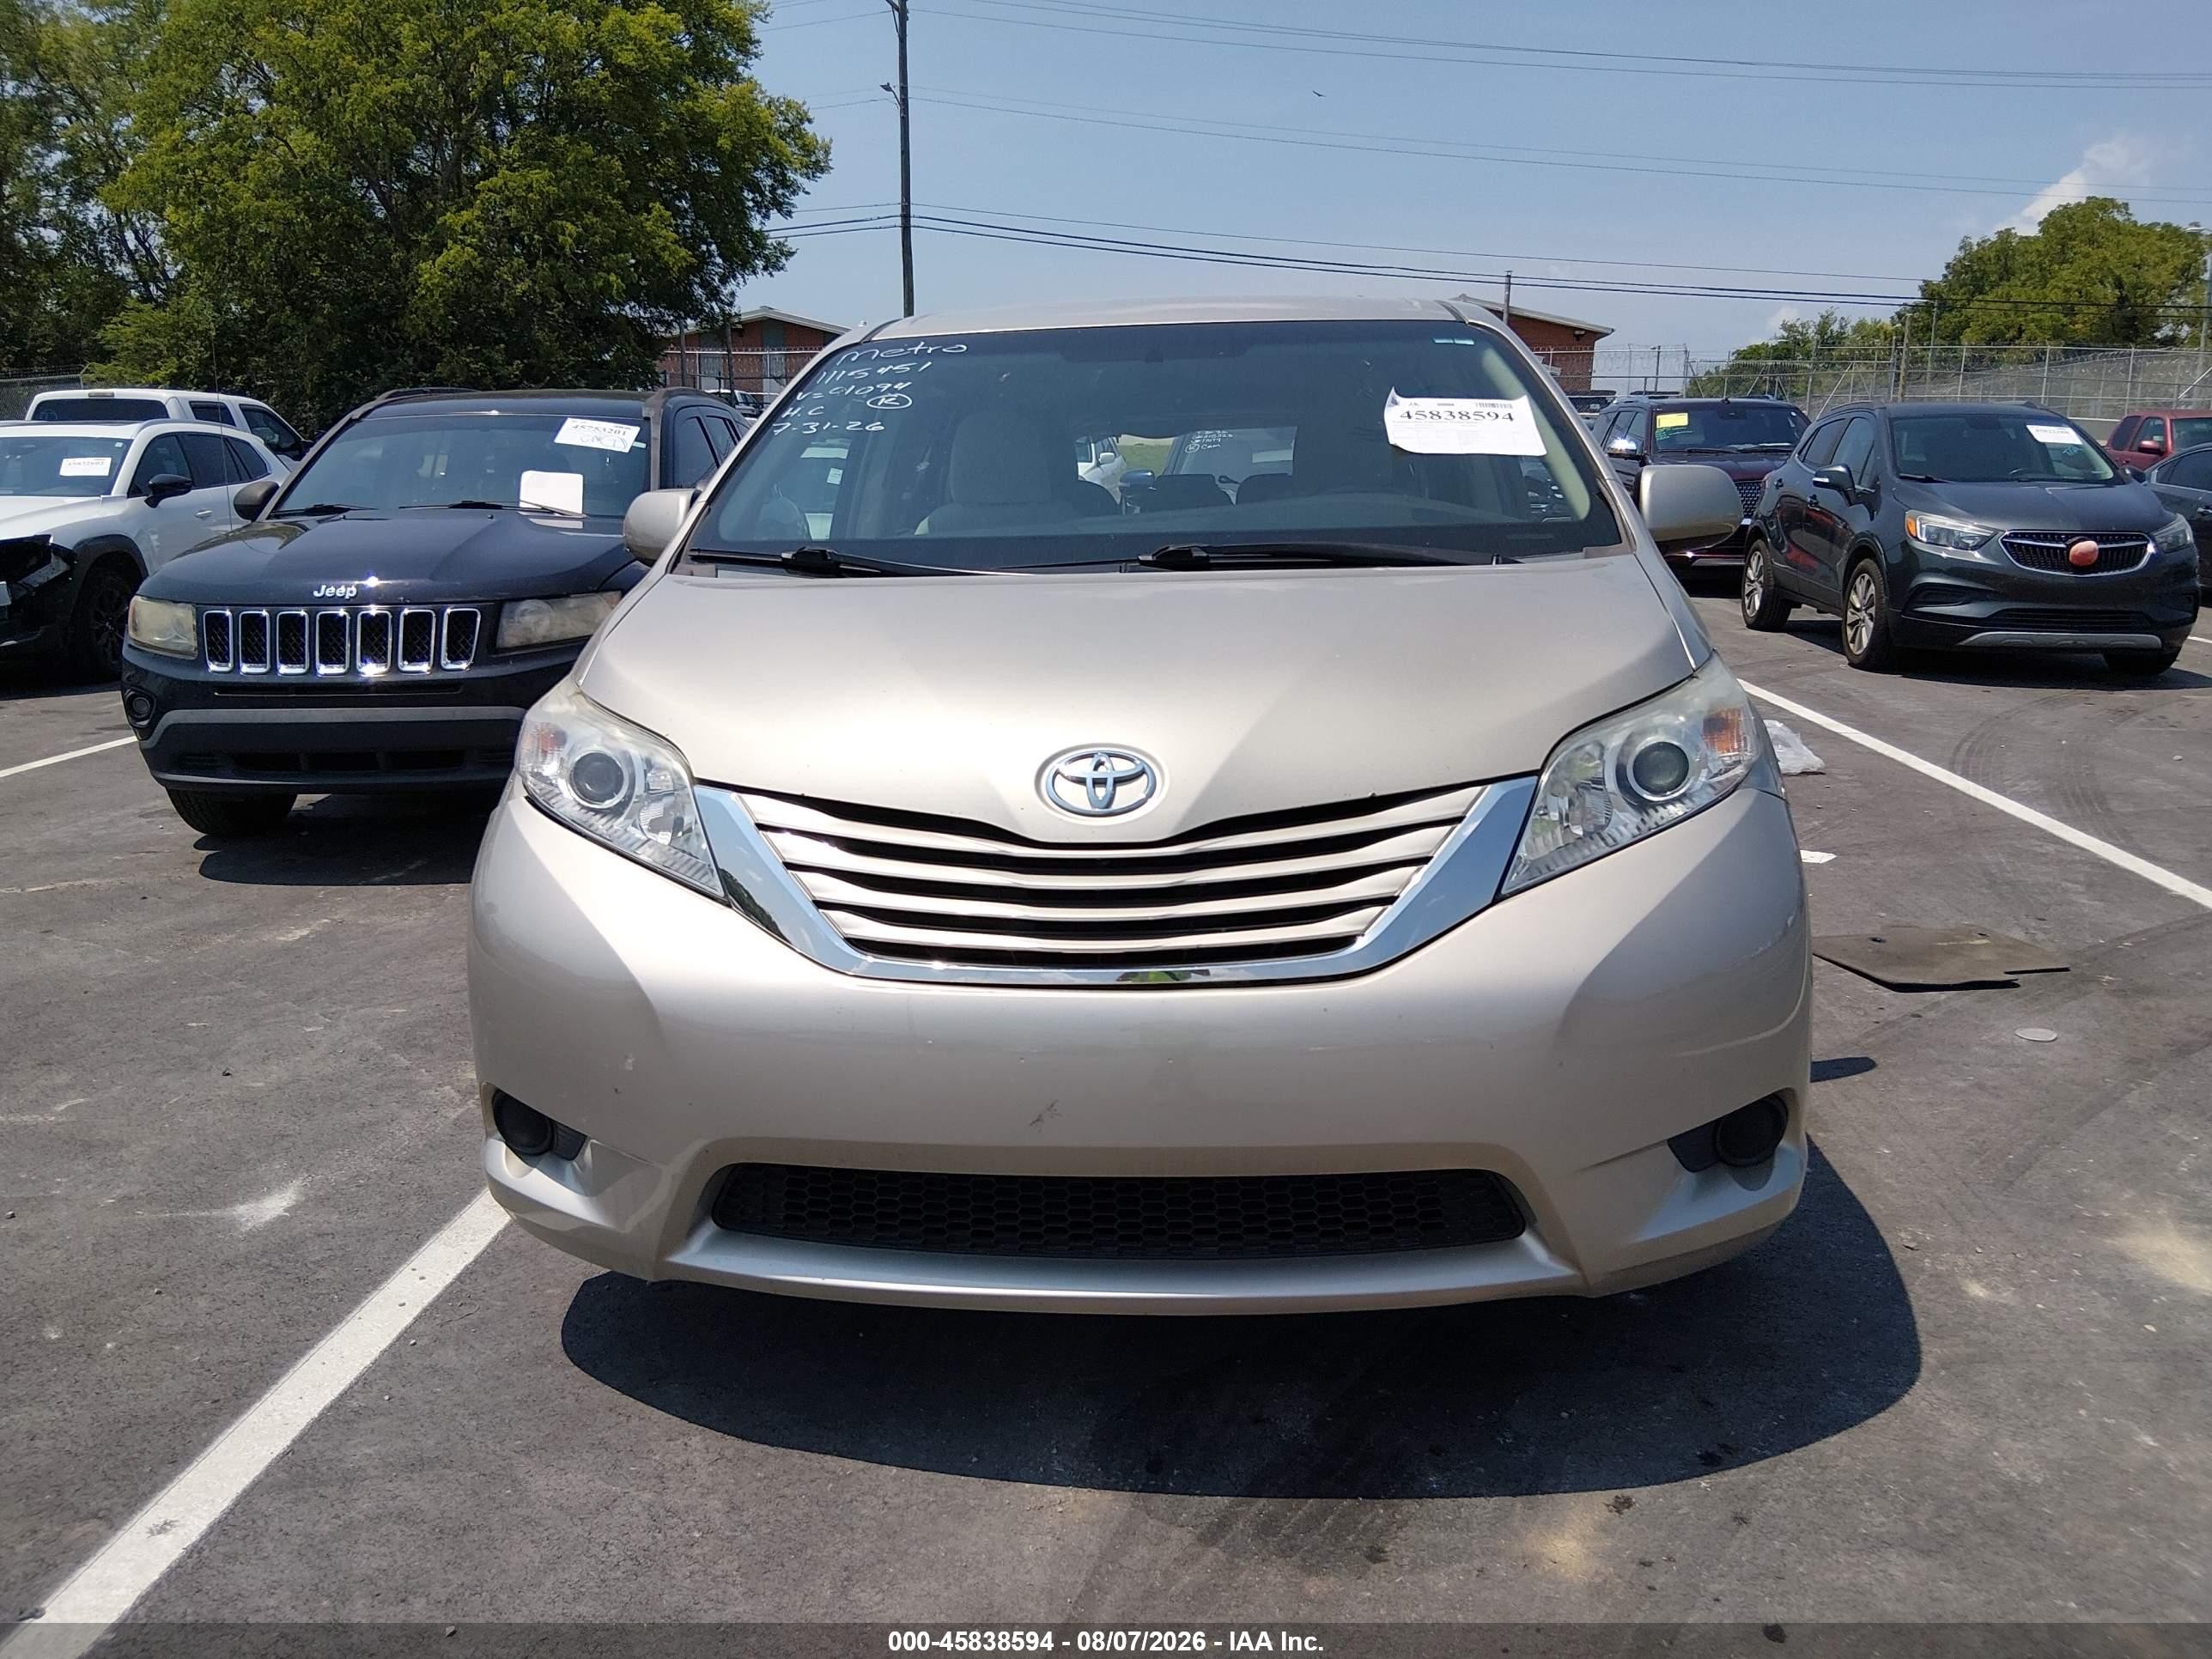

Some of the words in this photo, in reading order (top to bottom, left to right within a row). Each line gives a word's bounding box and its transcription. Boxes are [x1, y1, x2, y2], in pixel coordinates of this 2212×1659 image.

[1399, 410, 1516, 422] 45838594
[771, 421, 885, 436] 7-31-26
[313, 584, 357, 599] Jeep
